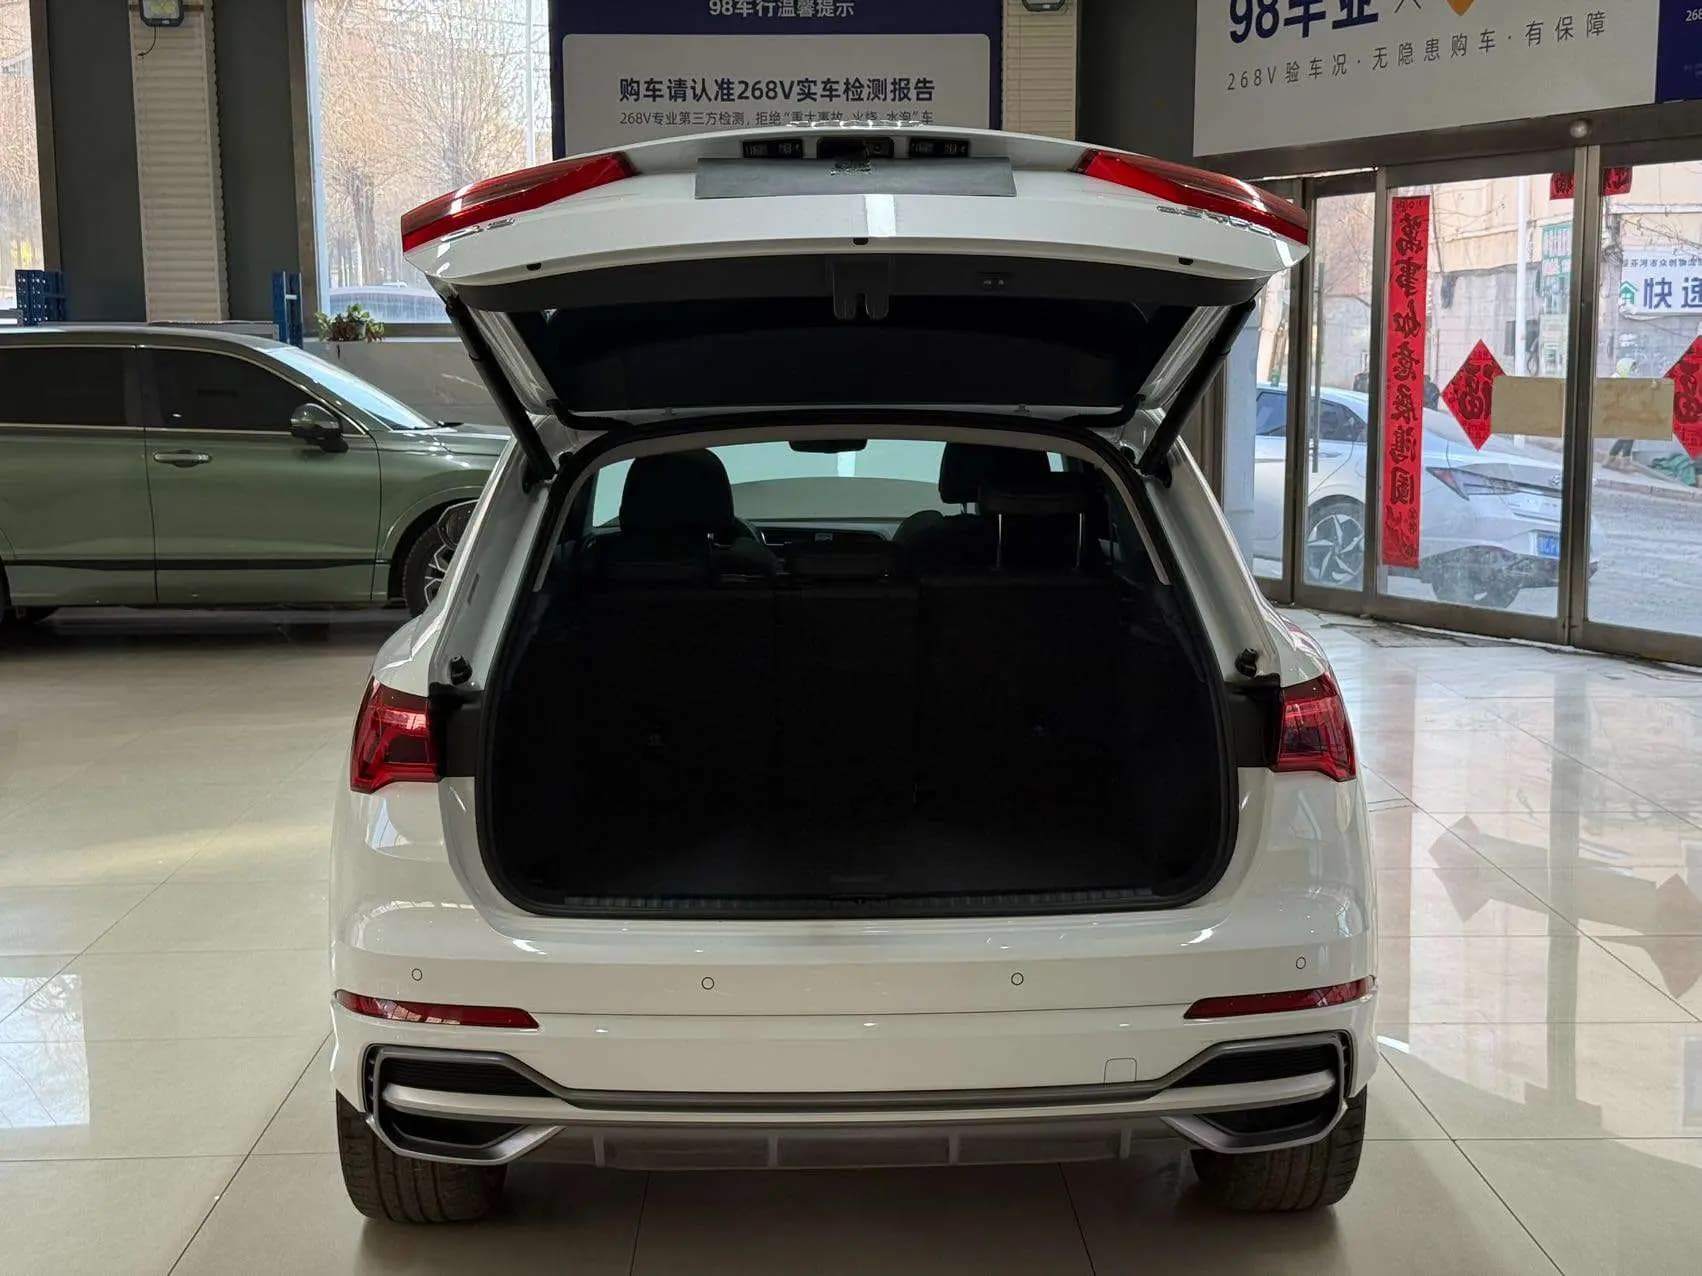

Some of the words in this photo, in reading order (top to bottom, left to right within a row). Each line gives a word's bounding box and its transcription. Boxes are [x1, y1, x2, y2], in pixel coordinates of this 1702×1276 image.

[708, 0, 854, 18] 98车行温馨提示
[619, 77, 935, 103] 购车请认准268V实车检测报告
